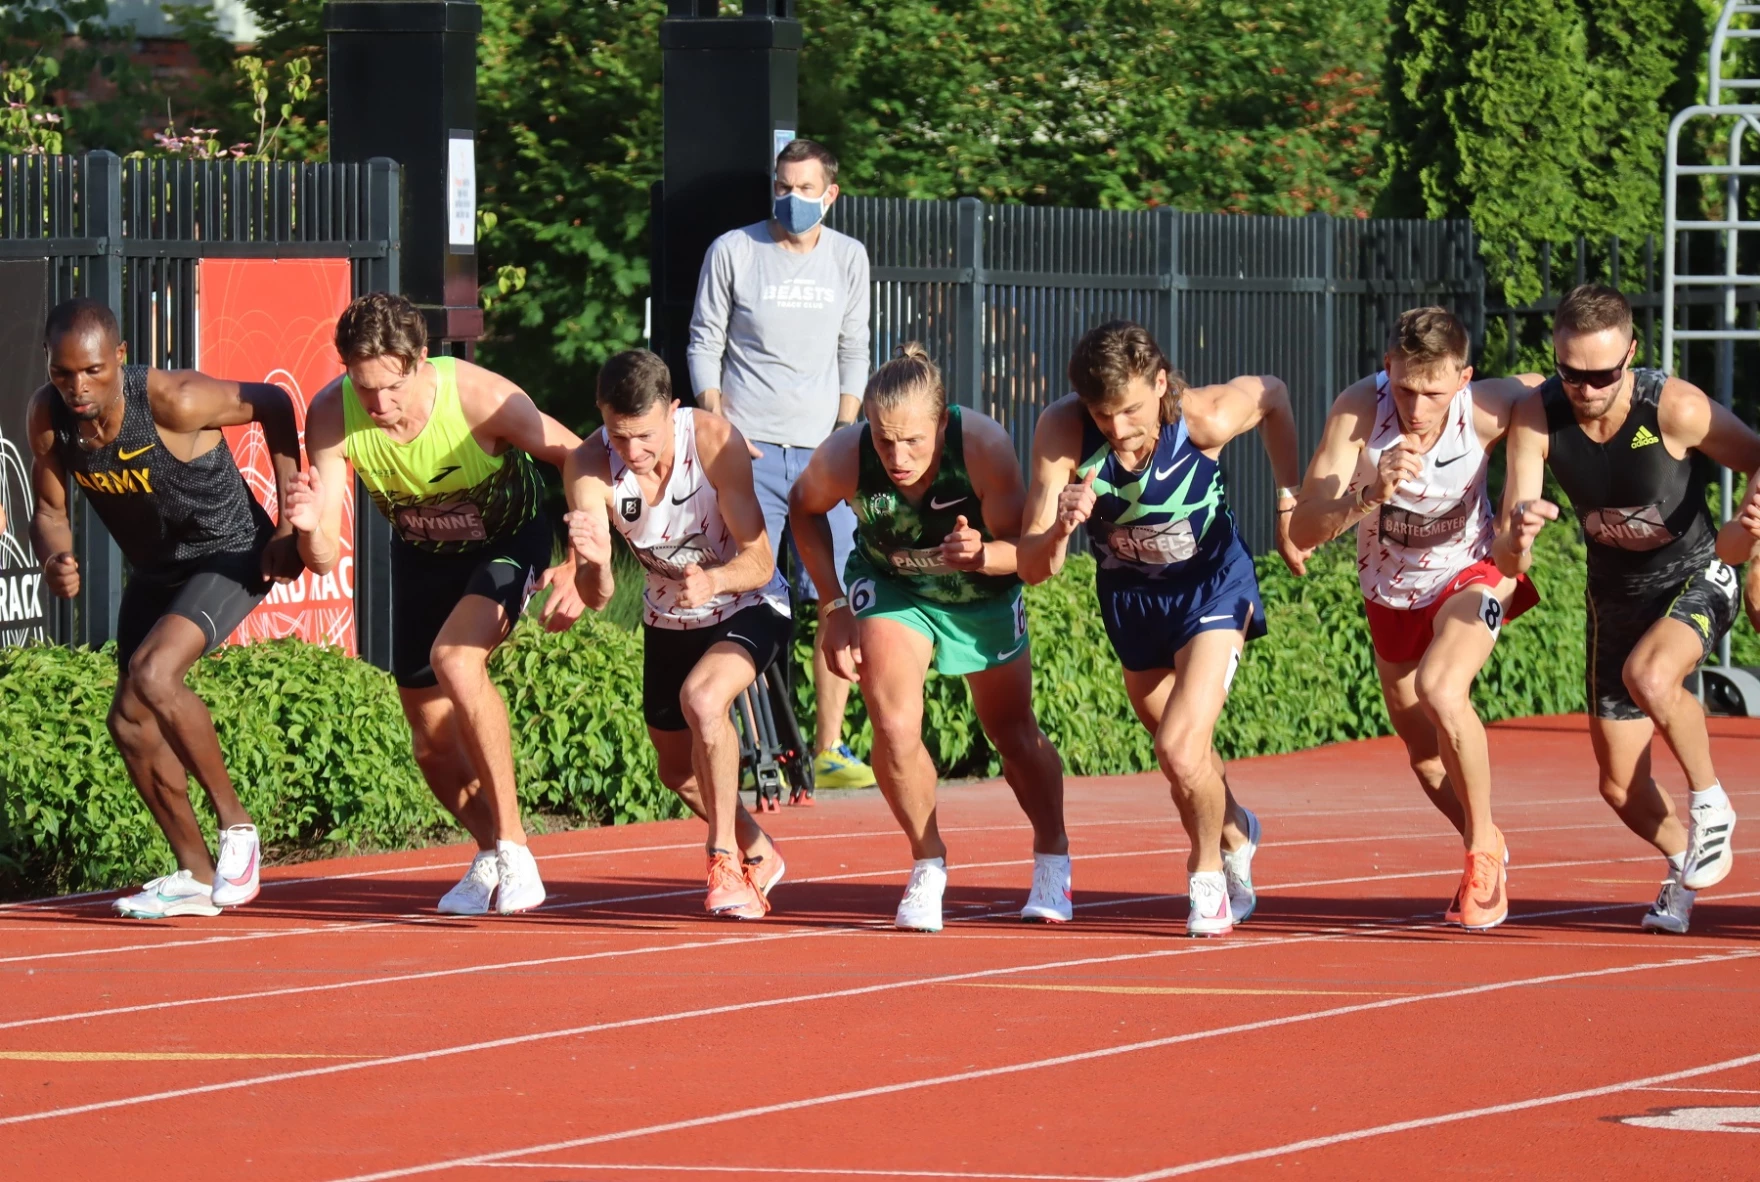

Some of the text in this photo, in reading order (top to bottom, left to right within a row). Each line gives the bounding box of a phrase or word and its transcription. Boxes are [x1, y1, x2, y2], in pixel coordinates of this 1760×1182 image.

[763, 284, 834, 303] BEASTS
[777, 300, 824, 309] TRACK CLUB
[1631, 436, 1659, 449] adidas
[75, 467, 153, 494] ARMY
[404, 513, 479, 530] WYNNE
[1386, 516, 1466, 537] BARTELSMEYER
[1600, 522, 1658, 539] AVILA
[1116, 531, 1191, 552] ENGELS
[851, 577, 870, 612] 6
[1485, 598, 1500, 631] 8
